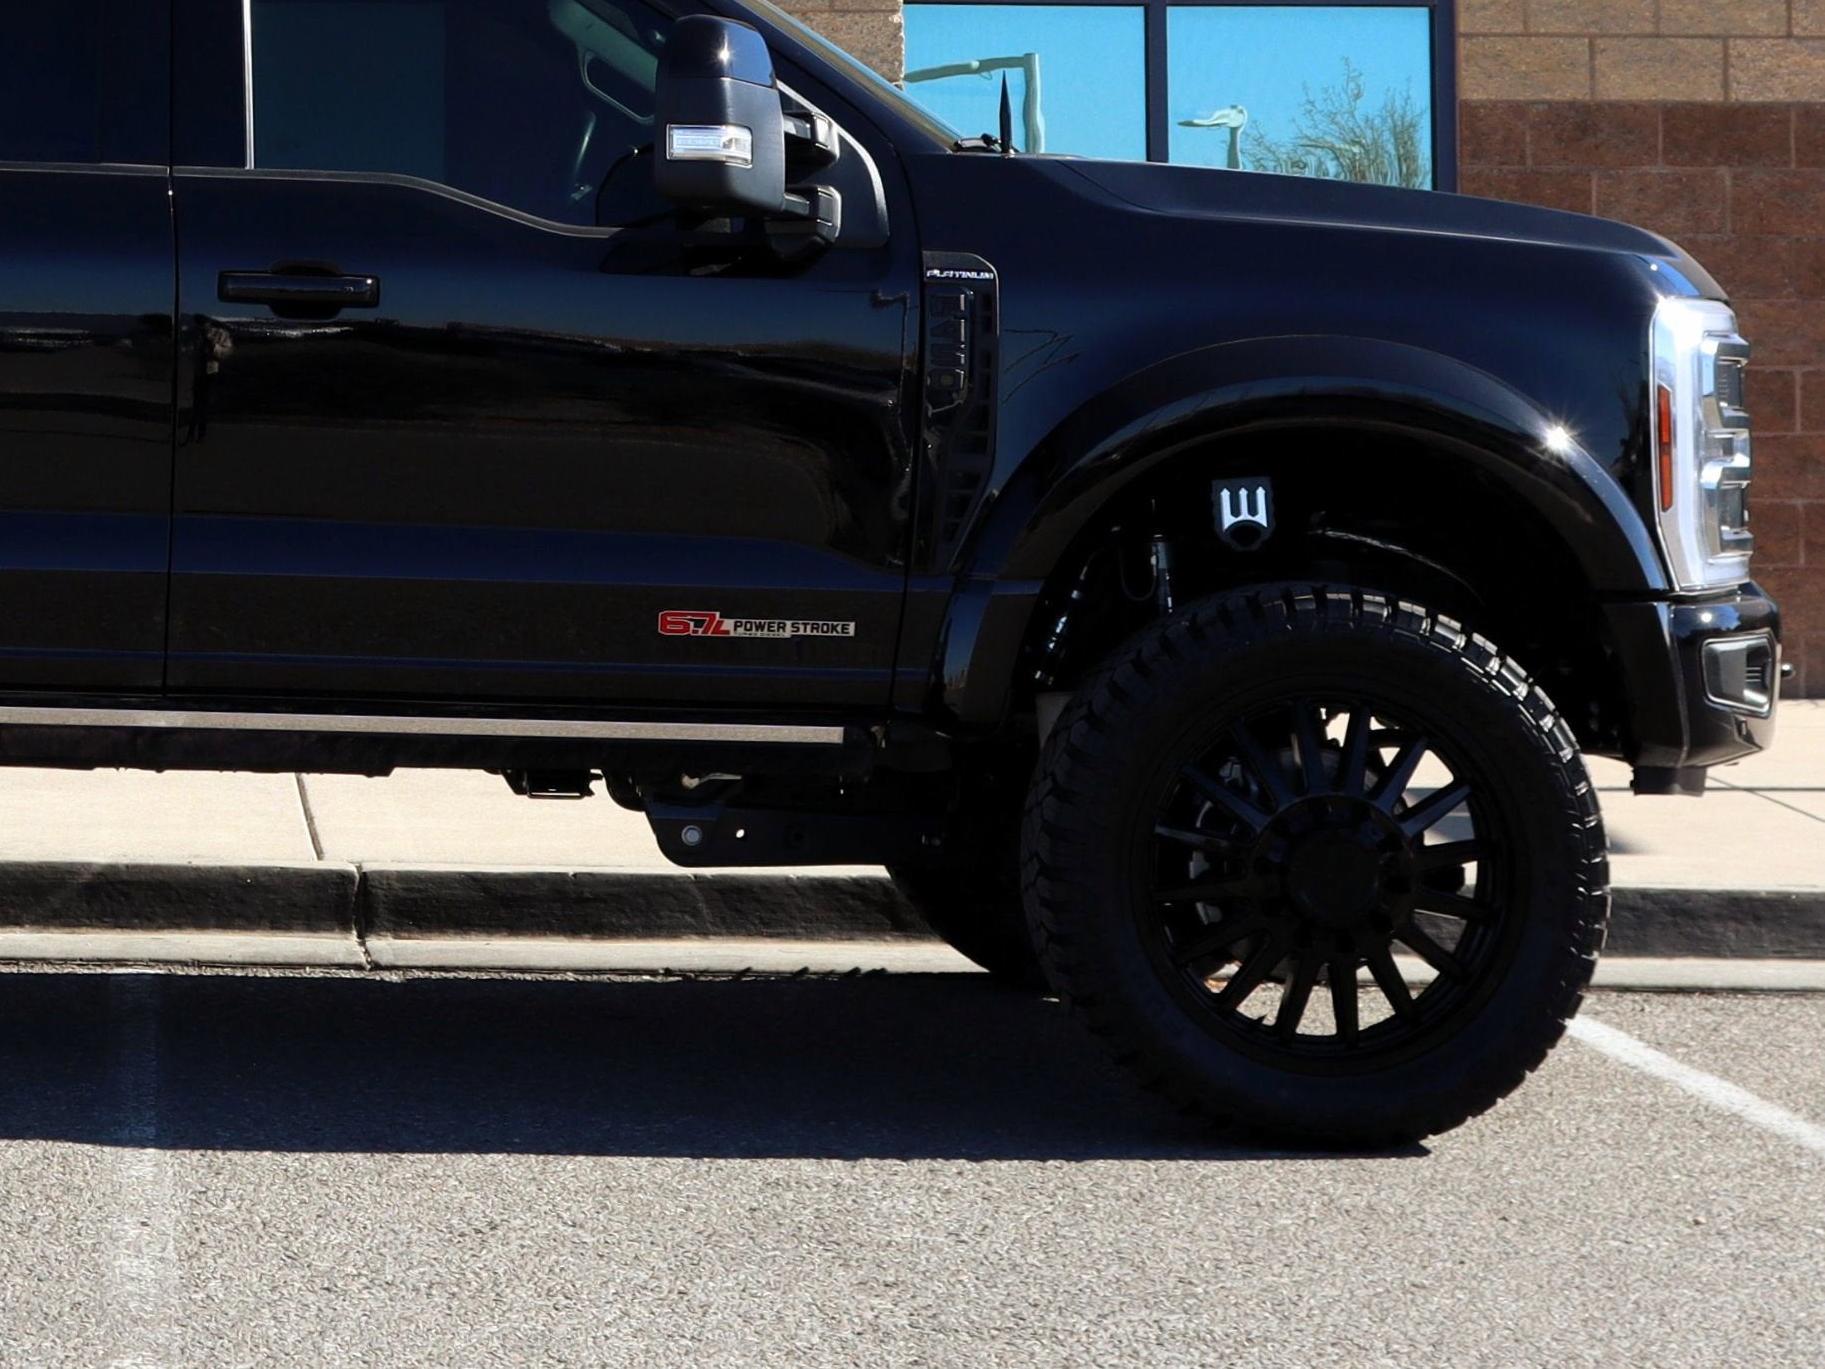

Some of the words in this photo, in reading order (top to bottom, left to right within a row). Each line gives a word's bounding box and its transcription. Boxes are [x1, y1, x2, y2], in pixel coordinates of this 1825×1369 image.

[658, 610, 731, 636] 6.7L
[733, 620, 786, 632] POWER
[790, 622, 850, 634] STROKE
